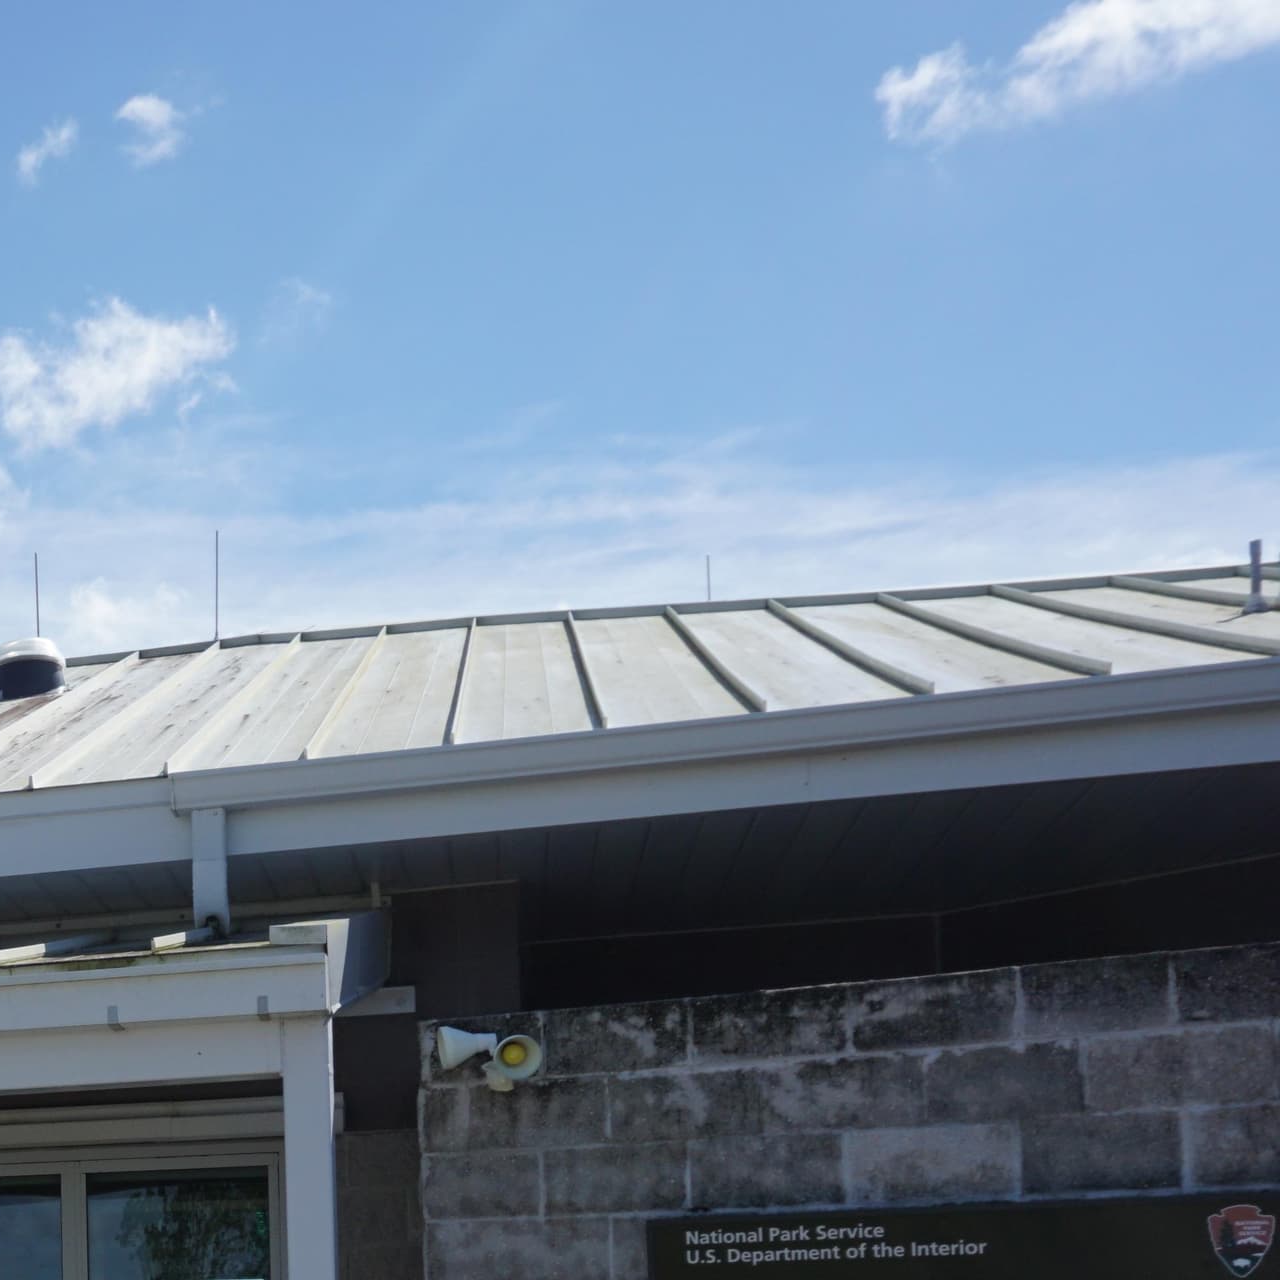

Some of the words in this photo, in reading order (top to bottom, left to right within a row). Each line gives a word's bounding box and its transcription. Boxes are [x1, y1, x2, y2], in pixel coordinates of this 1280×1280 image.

[685, 1227, 763, 1246] National
[768, 1225, 811, 1242] Park
[816, 1223, 885, 1240] Service
[685, 1249, 722, 1265] U.S.
[727, 1245, 841, 1266] Department
[846, 1242, 866, 1259] of
[871, 1242, 905, 1258] the
[911, 1239, 987, 1257] Interior
